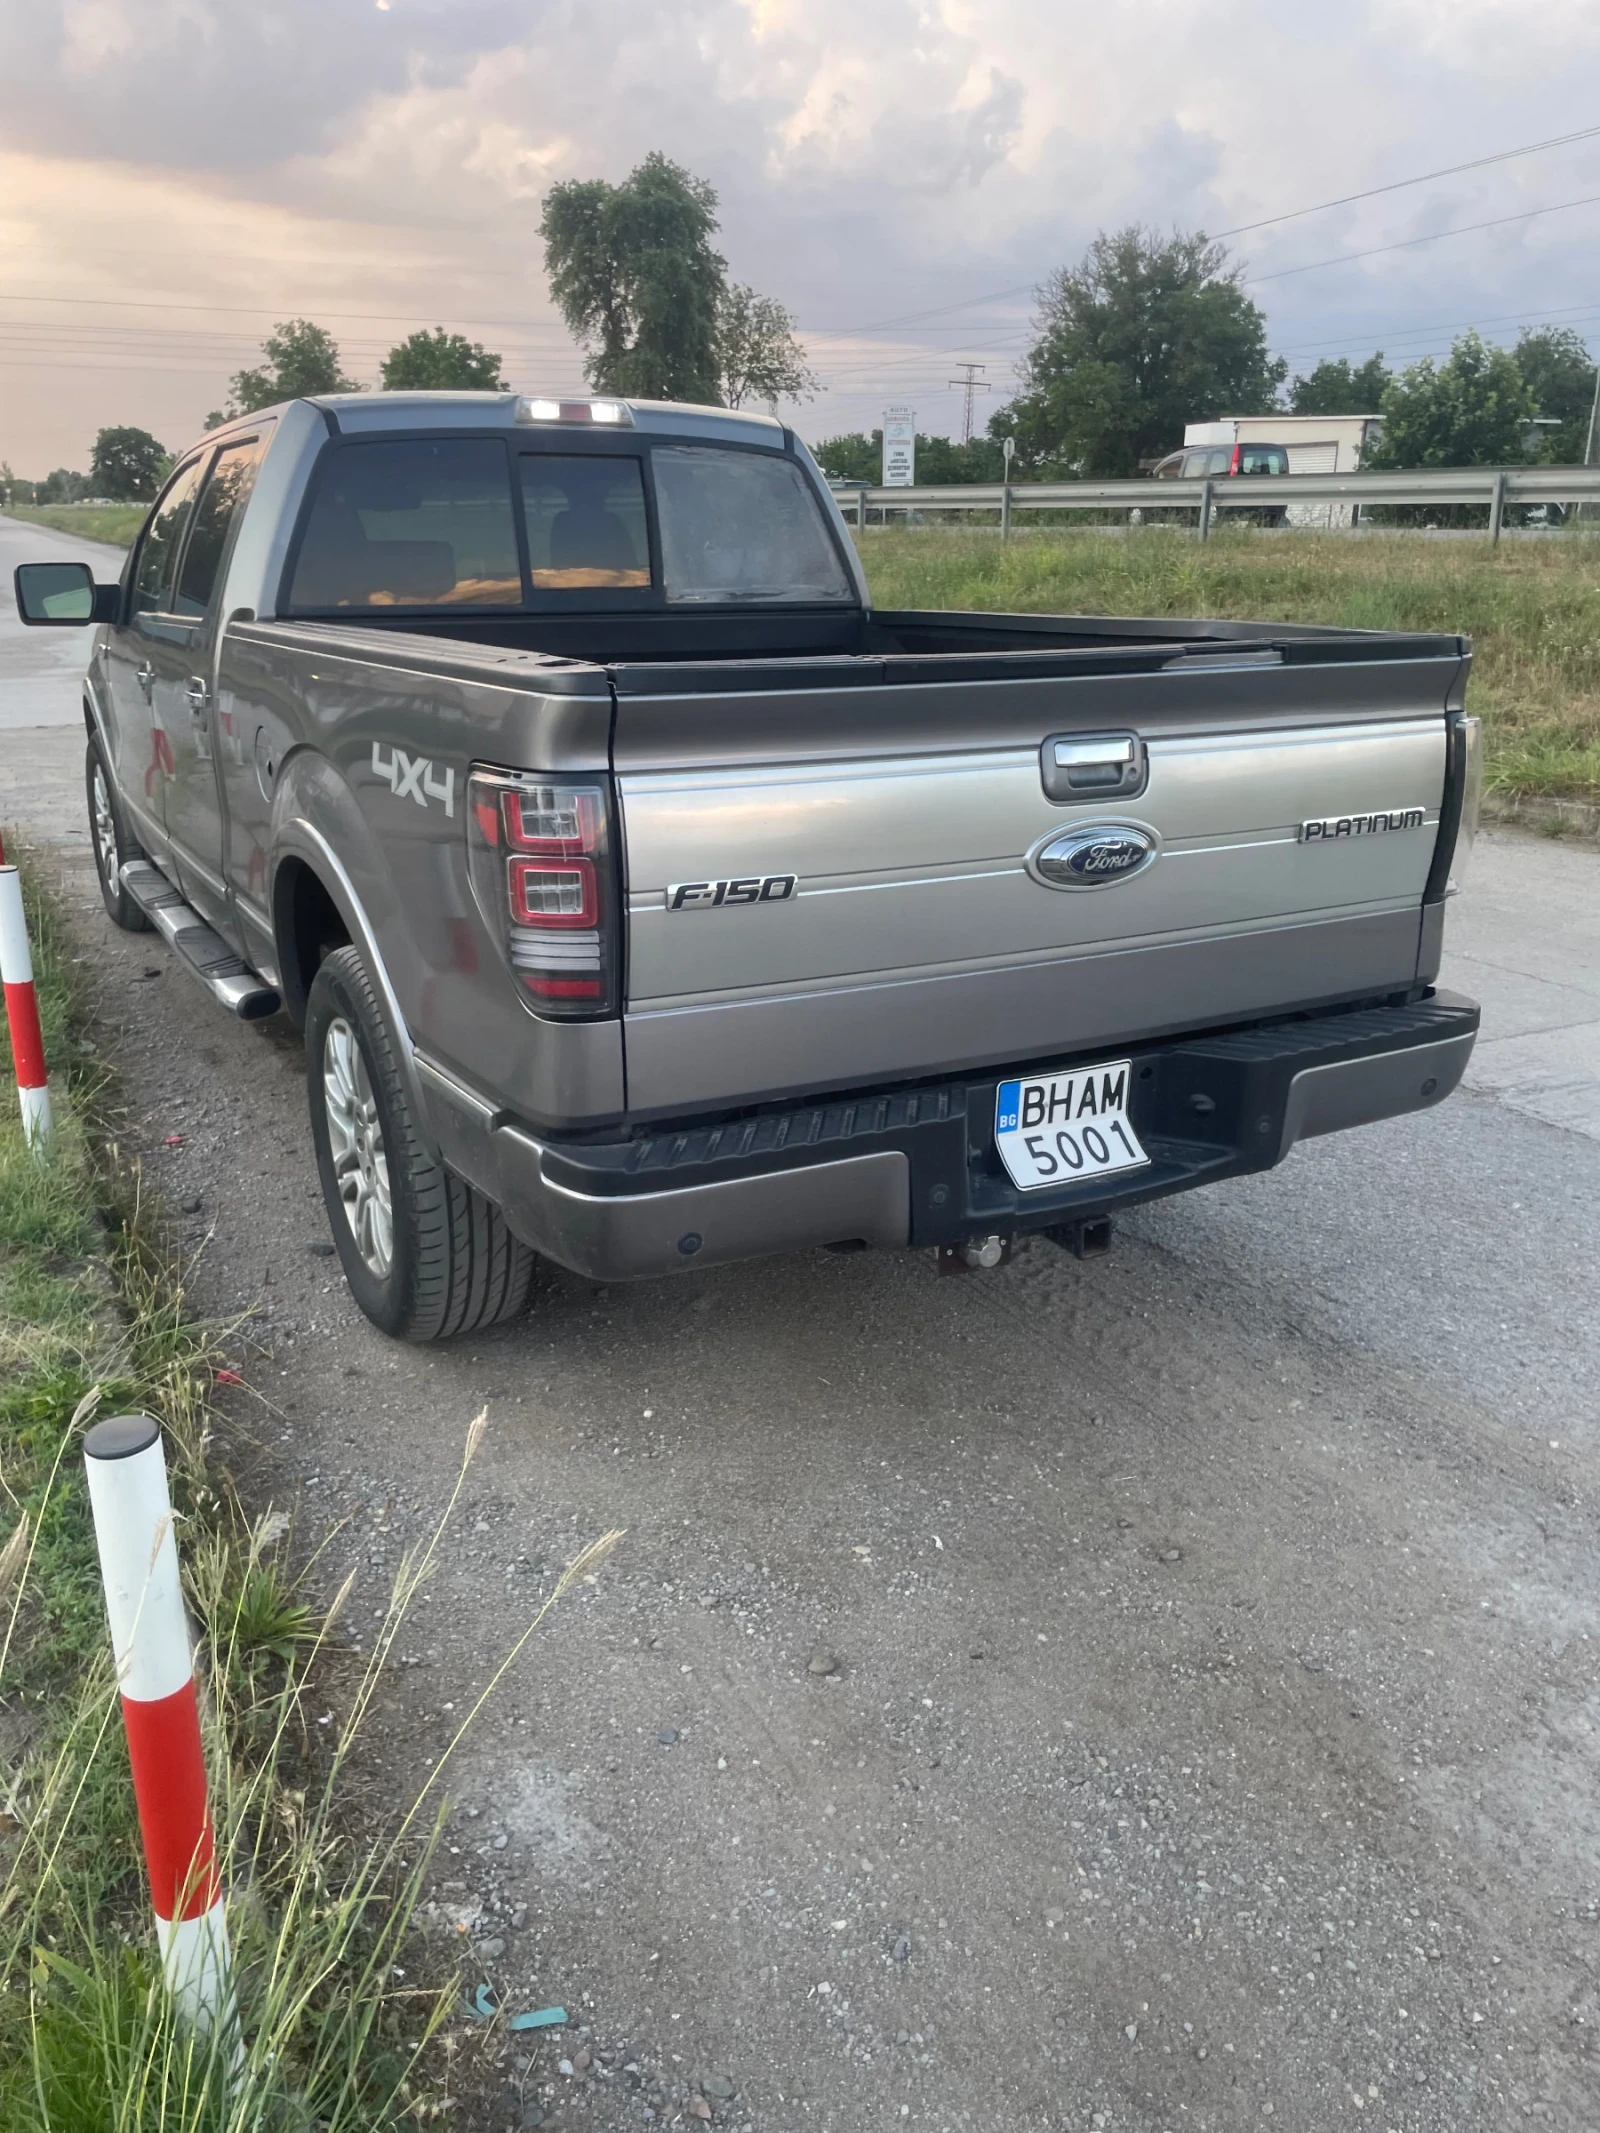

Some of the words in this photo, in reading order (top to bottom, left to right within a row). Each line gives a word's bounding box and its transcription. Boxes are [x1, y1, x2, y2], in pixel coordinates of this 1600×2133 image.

[372, 741, 455, 818] 4X4
[1305, 810, 1423, 841] PLATINUM
[1085, 841, 1133, 871] Ford
[671, 875, 796, 909] F-150
[1022, 1070, 1125, 1129] BHAM
[1000, 1114, 1016, 1128] BG
[1024, 1120, 1136, 1176] 5001
